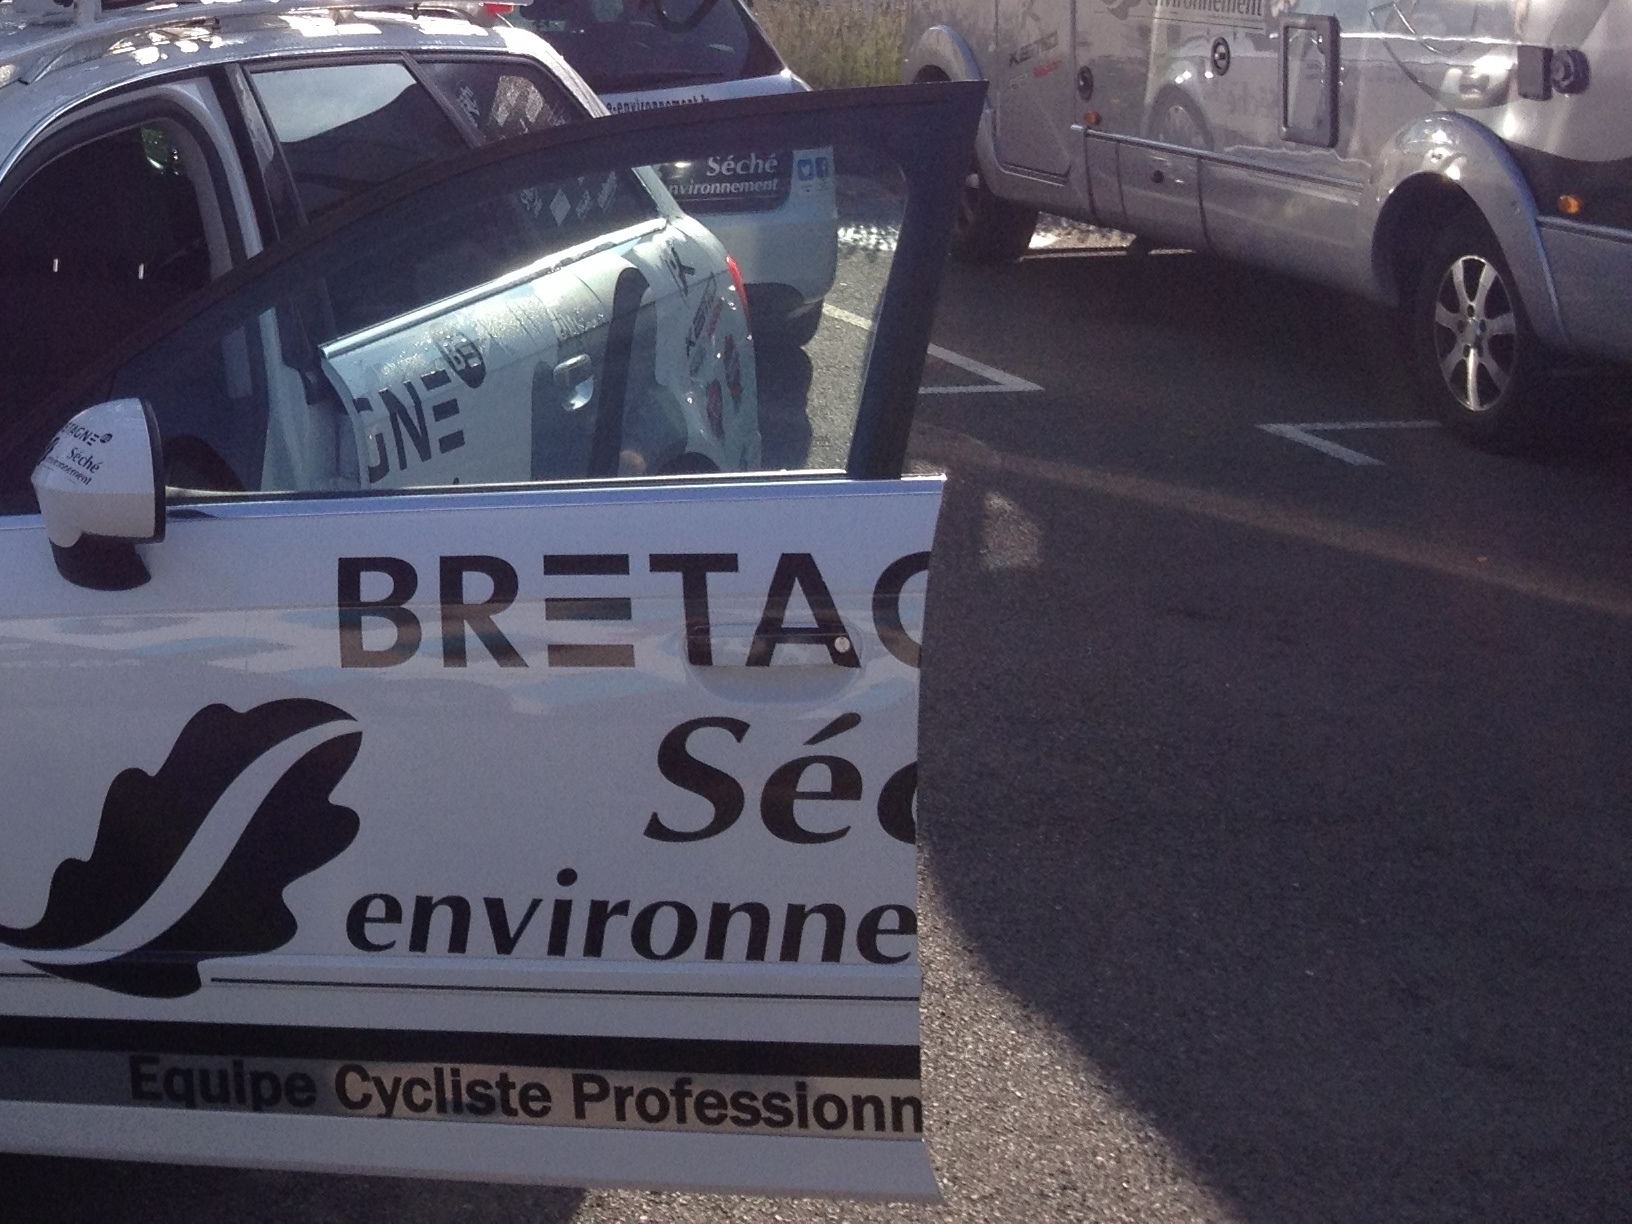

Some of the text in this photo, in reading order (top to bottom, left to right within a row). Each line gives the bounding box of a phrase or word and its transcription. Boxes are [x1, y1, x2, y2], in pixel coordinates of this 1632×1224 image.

[706, 152, 779, 177] Séché
[667, 178, 779, 197] nvironnement
[67, 447, 104, 474] Séché
[129, 1055, 317, 1112] Equipe
[334, 1063, 553, 1118] Cycliste
